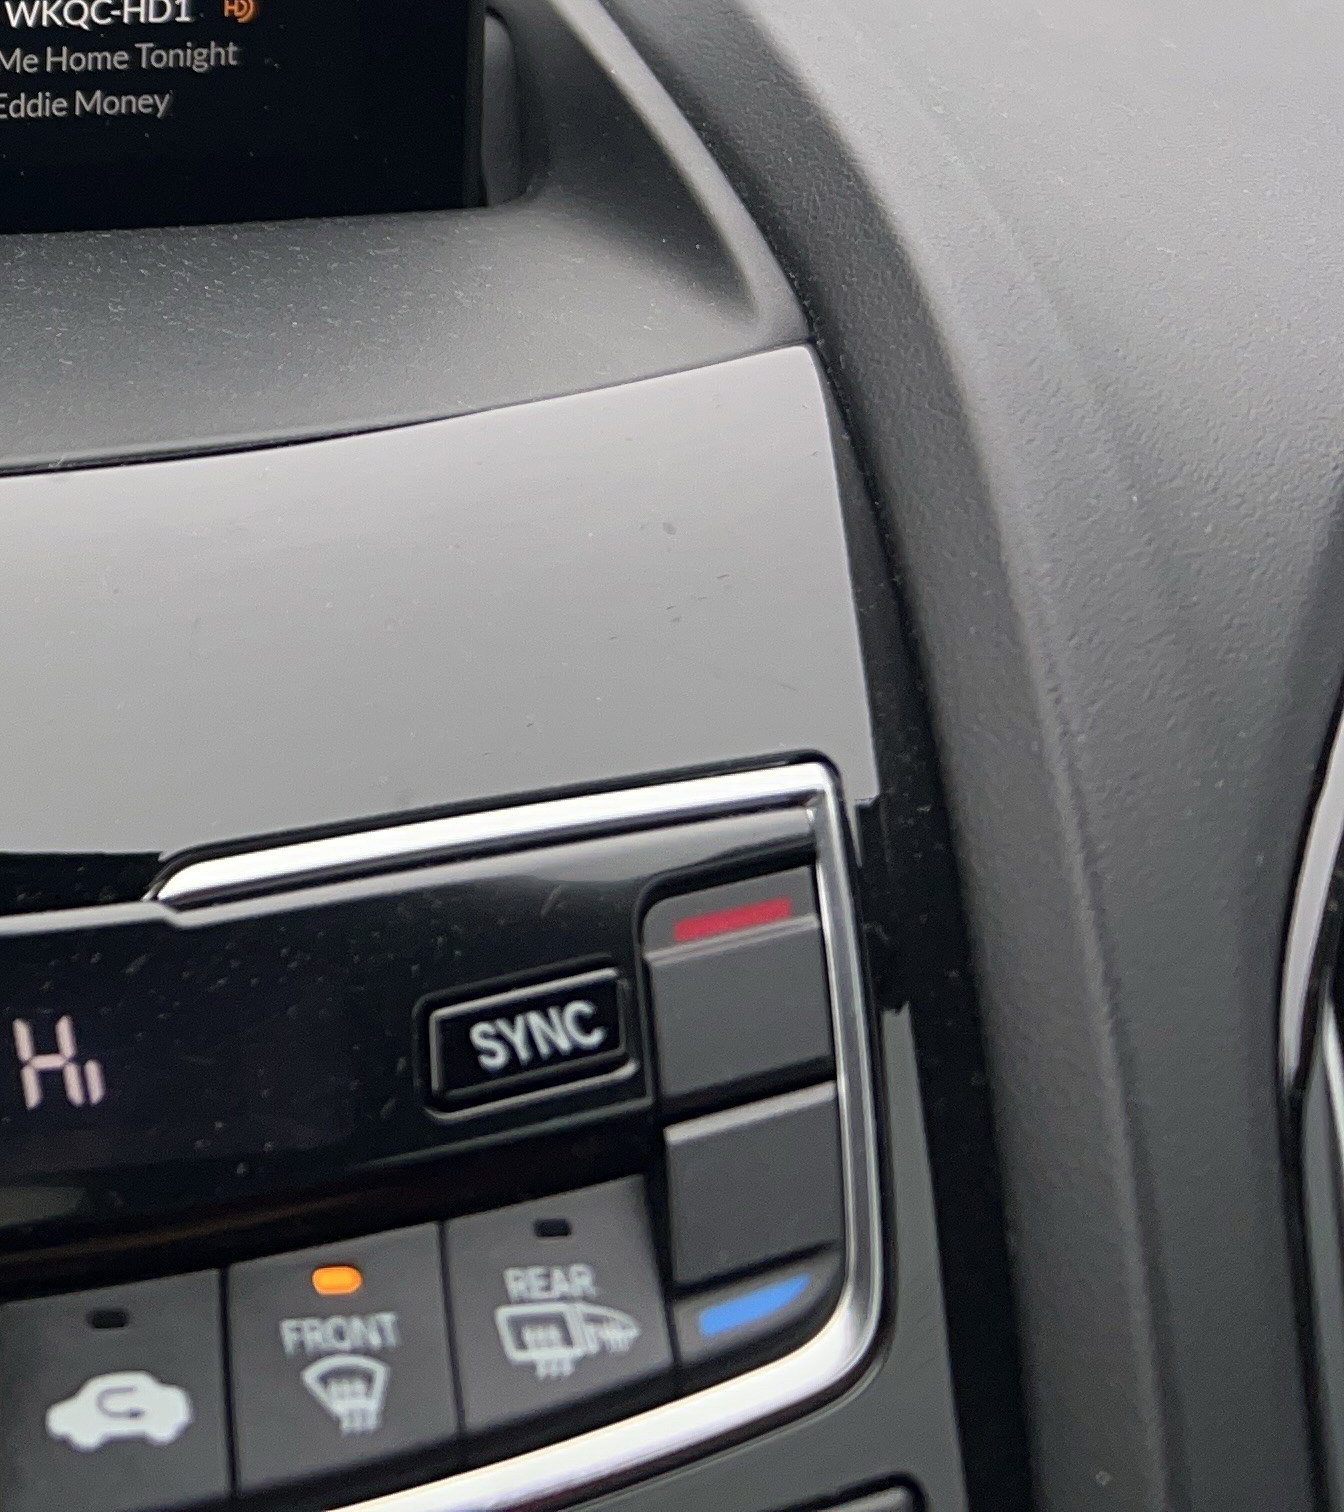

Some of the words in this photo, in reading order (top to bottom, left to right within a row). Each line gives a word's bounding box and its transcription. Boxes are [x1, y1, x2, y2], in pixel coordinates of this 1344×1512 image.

[45, 44, 129, 73] Home
[134, 40, 238, 74] Tonight
[74, 89, 170, 119] Money
[468, 998, 609, 1077] SYNC
[503, 1264, 597, 1303] REAR
[280, 1310, 400, 1358] FRONT
